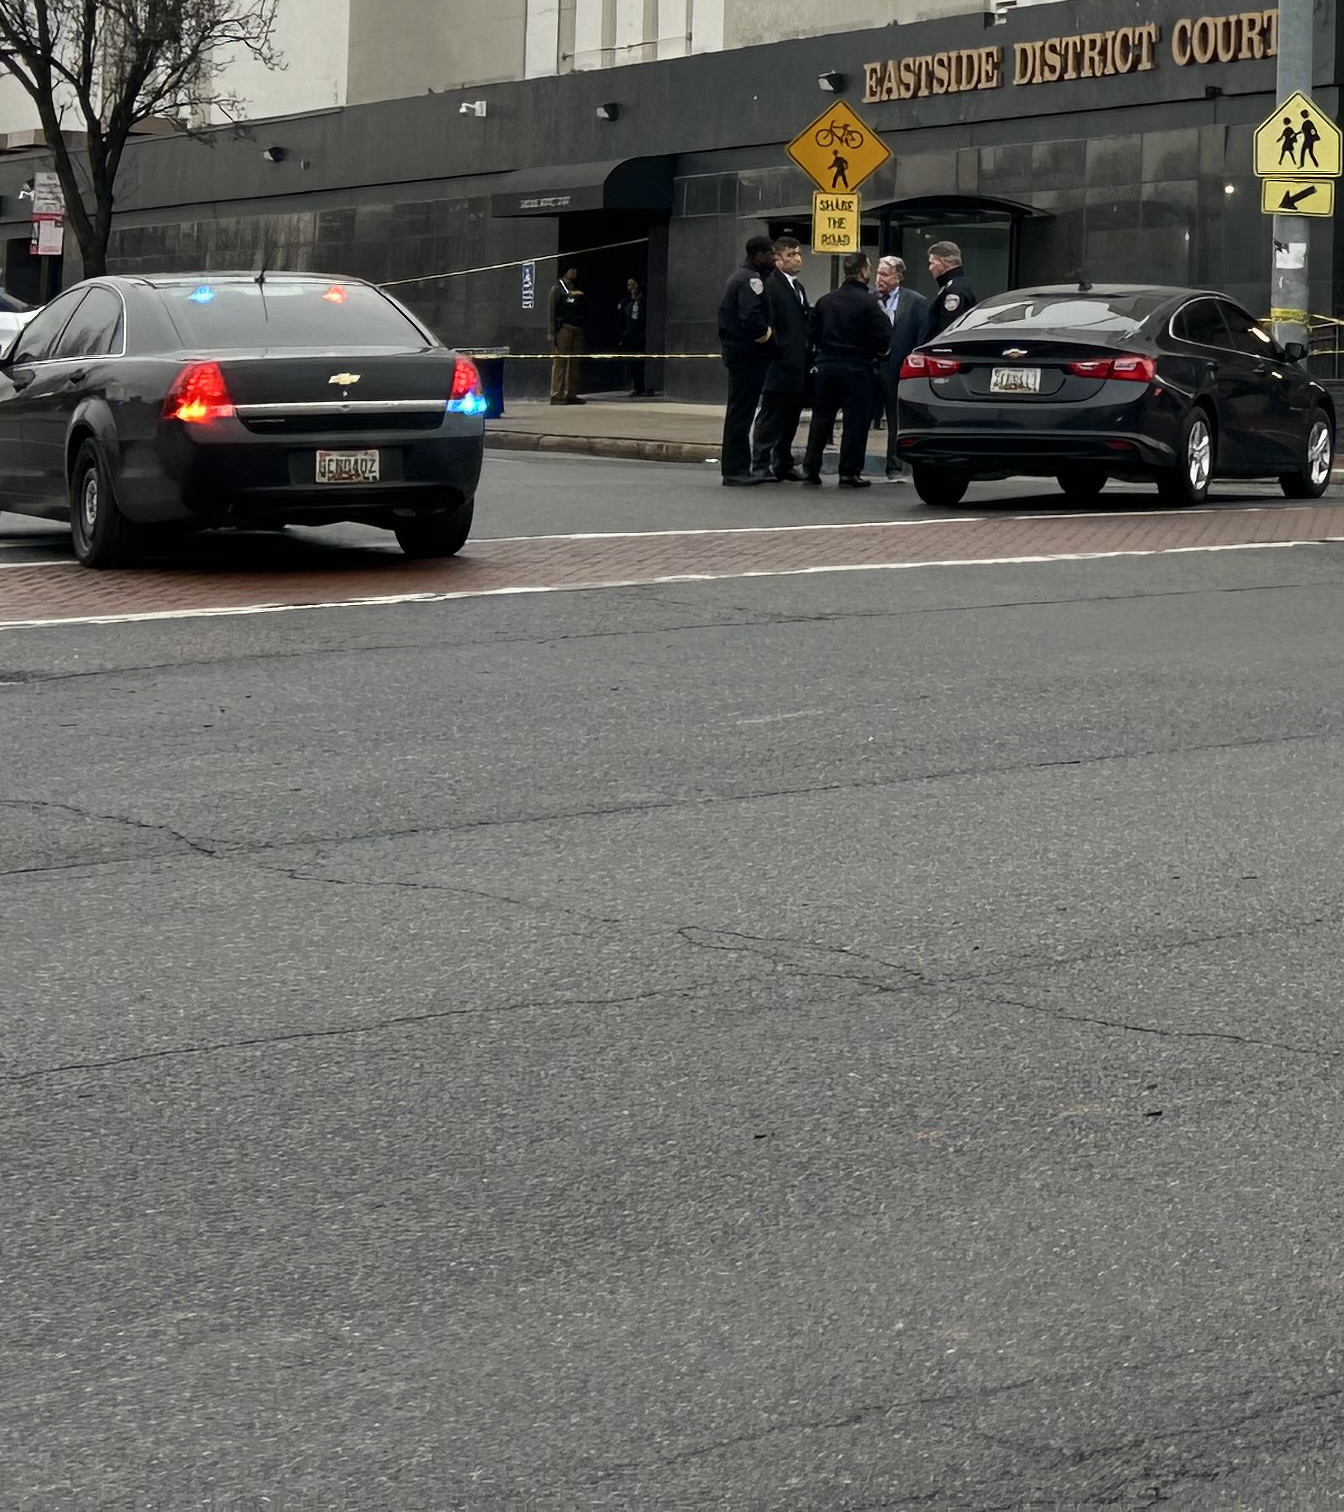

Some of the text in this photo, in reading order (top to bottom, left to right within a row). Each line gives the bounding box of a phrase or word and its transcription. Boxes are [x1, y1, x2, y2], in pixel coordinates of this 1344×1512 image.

[862, 8, 1279, 103] EASTSIDE DISTRICT COURT
[827, 217, 847, 229] THE
